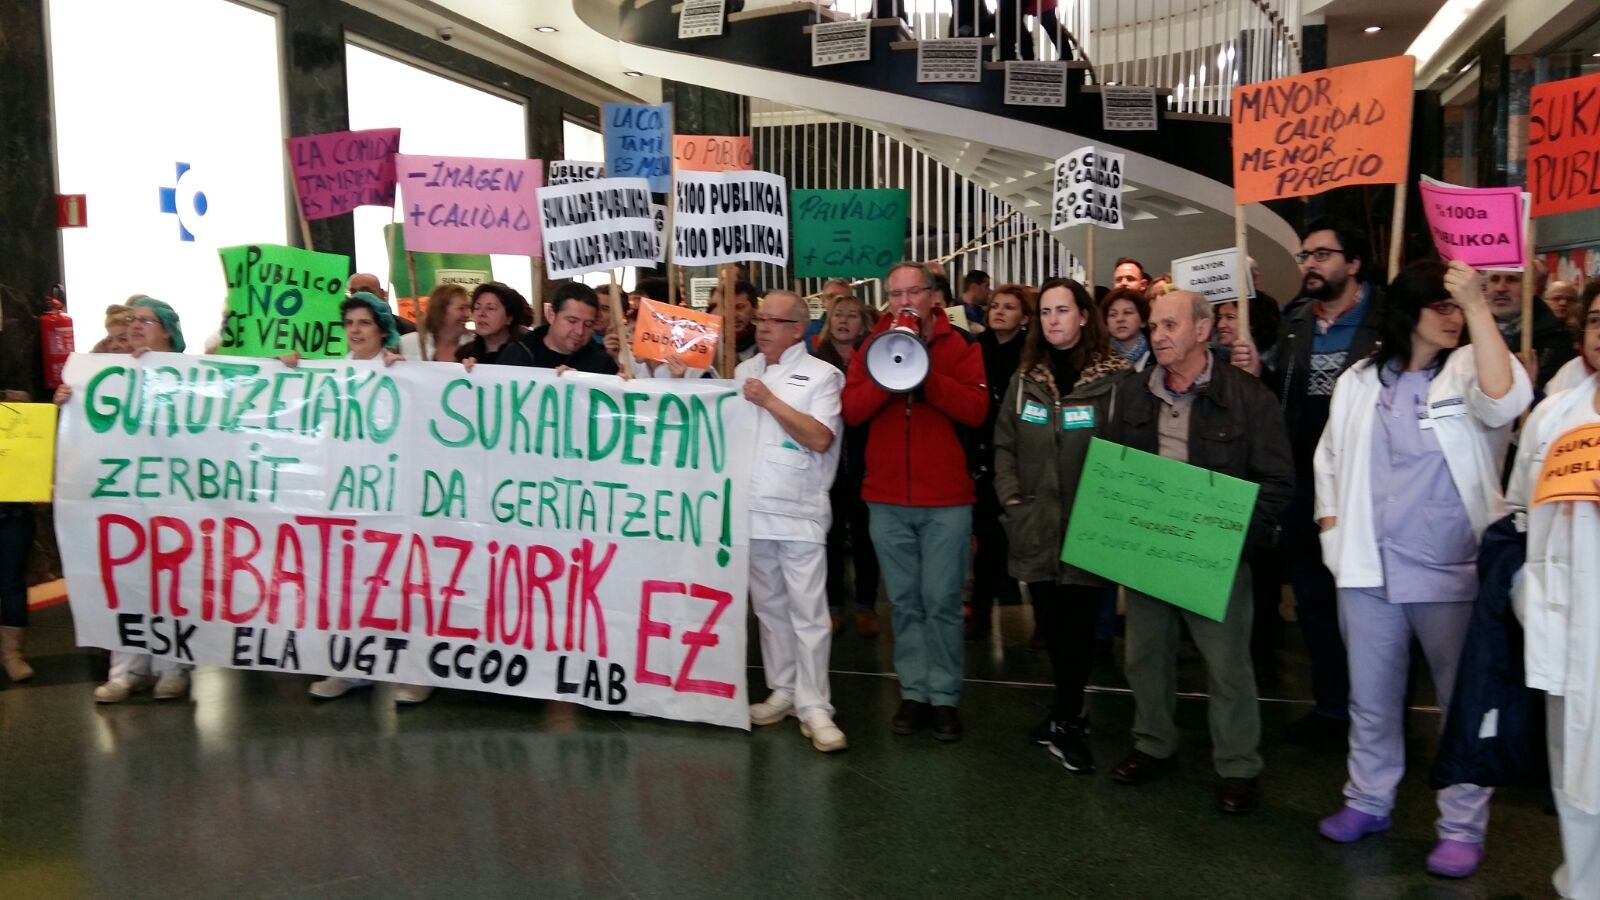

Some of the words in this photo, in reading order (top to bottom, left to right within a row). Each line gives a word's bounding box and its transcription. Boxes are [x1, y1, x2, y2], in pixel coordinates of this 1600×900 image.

[1238, 76, 1332, 124] MAYOR
[1275, 98, 1385, 145] CALIDAD
[296, 140, 326, 169] LA
[614, 157, 634, 173] ES
[1240, 137, 1336, 172] MENOR
[676, 180, 706, 215] %100
[710, 181, 784, 217] PUBLIKOA
[799, 193, 899, 222] PRIVADO
[675, 225, 708, 258] %100
[713, 224, 785, 259] PUBLIKOA
[823, 246, 894, 268] CARO
[246, 245, 343, 295] PUBLICO
[1190, 273, 1231, 286] CALIDAD
[1191, 260, 1225, 271] MAYOR
[247, 284, 304, 318] NO
[1202, 286, 1234, 296] BLICA
[221, 310, 246, 349] SE
[256, 318, 346, 357] VENDE
[641, 331, 708, 355] puboa
[84, 358, 400, 444] GURUTZETAKO
[429, 378, 737, 473] SUKALDEAN
[91, 443, 300, 502] ZERBAIT
[329, 453, 399, 512] ARI
[420, 468, 466, 518] DA
[97, 513, 618, 658] PRIBATIZAZIORIK
[634, 580, 737, 699] EZ
[117, 613, 196, 662] ESK
[231, 626, 300, 671] ELA
[328, 634, 409, 676] UGT
[428, 641, 528, 687] CCOO
[555, 655, 628, 706] LAB
